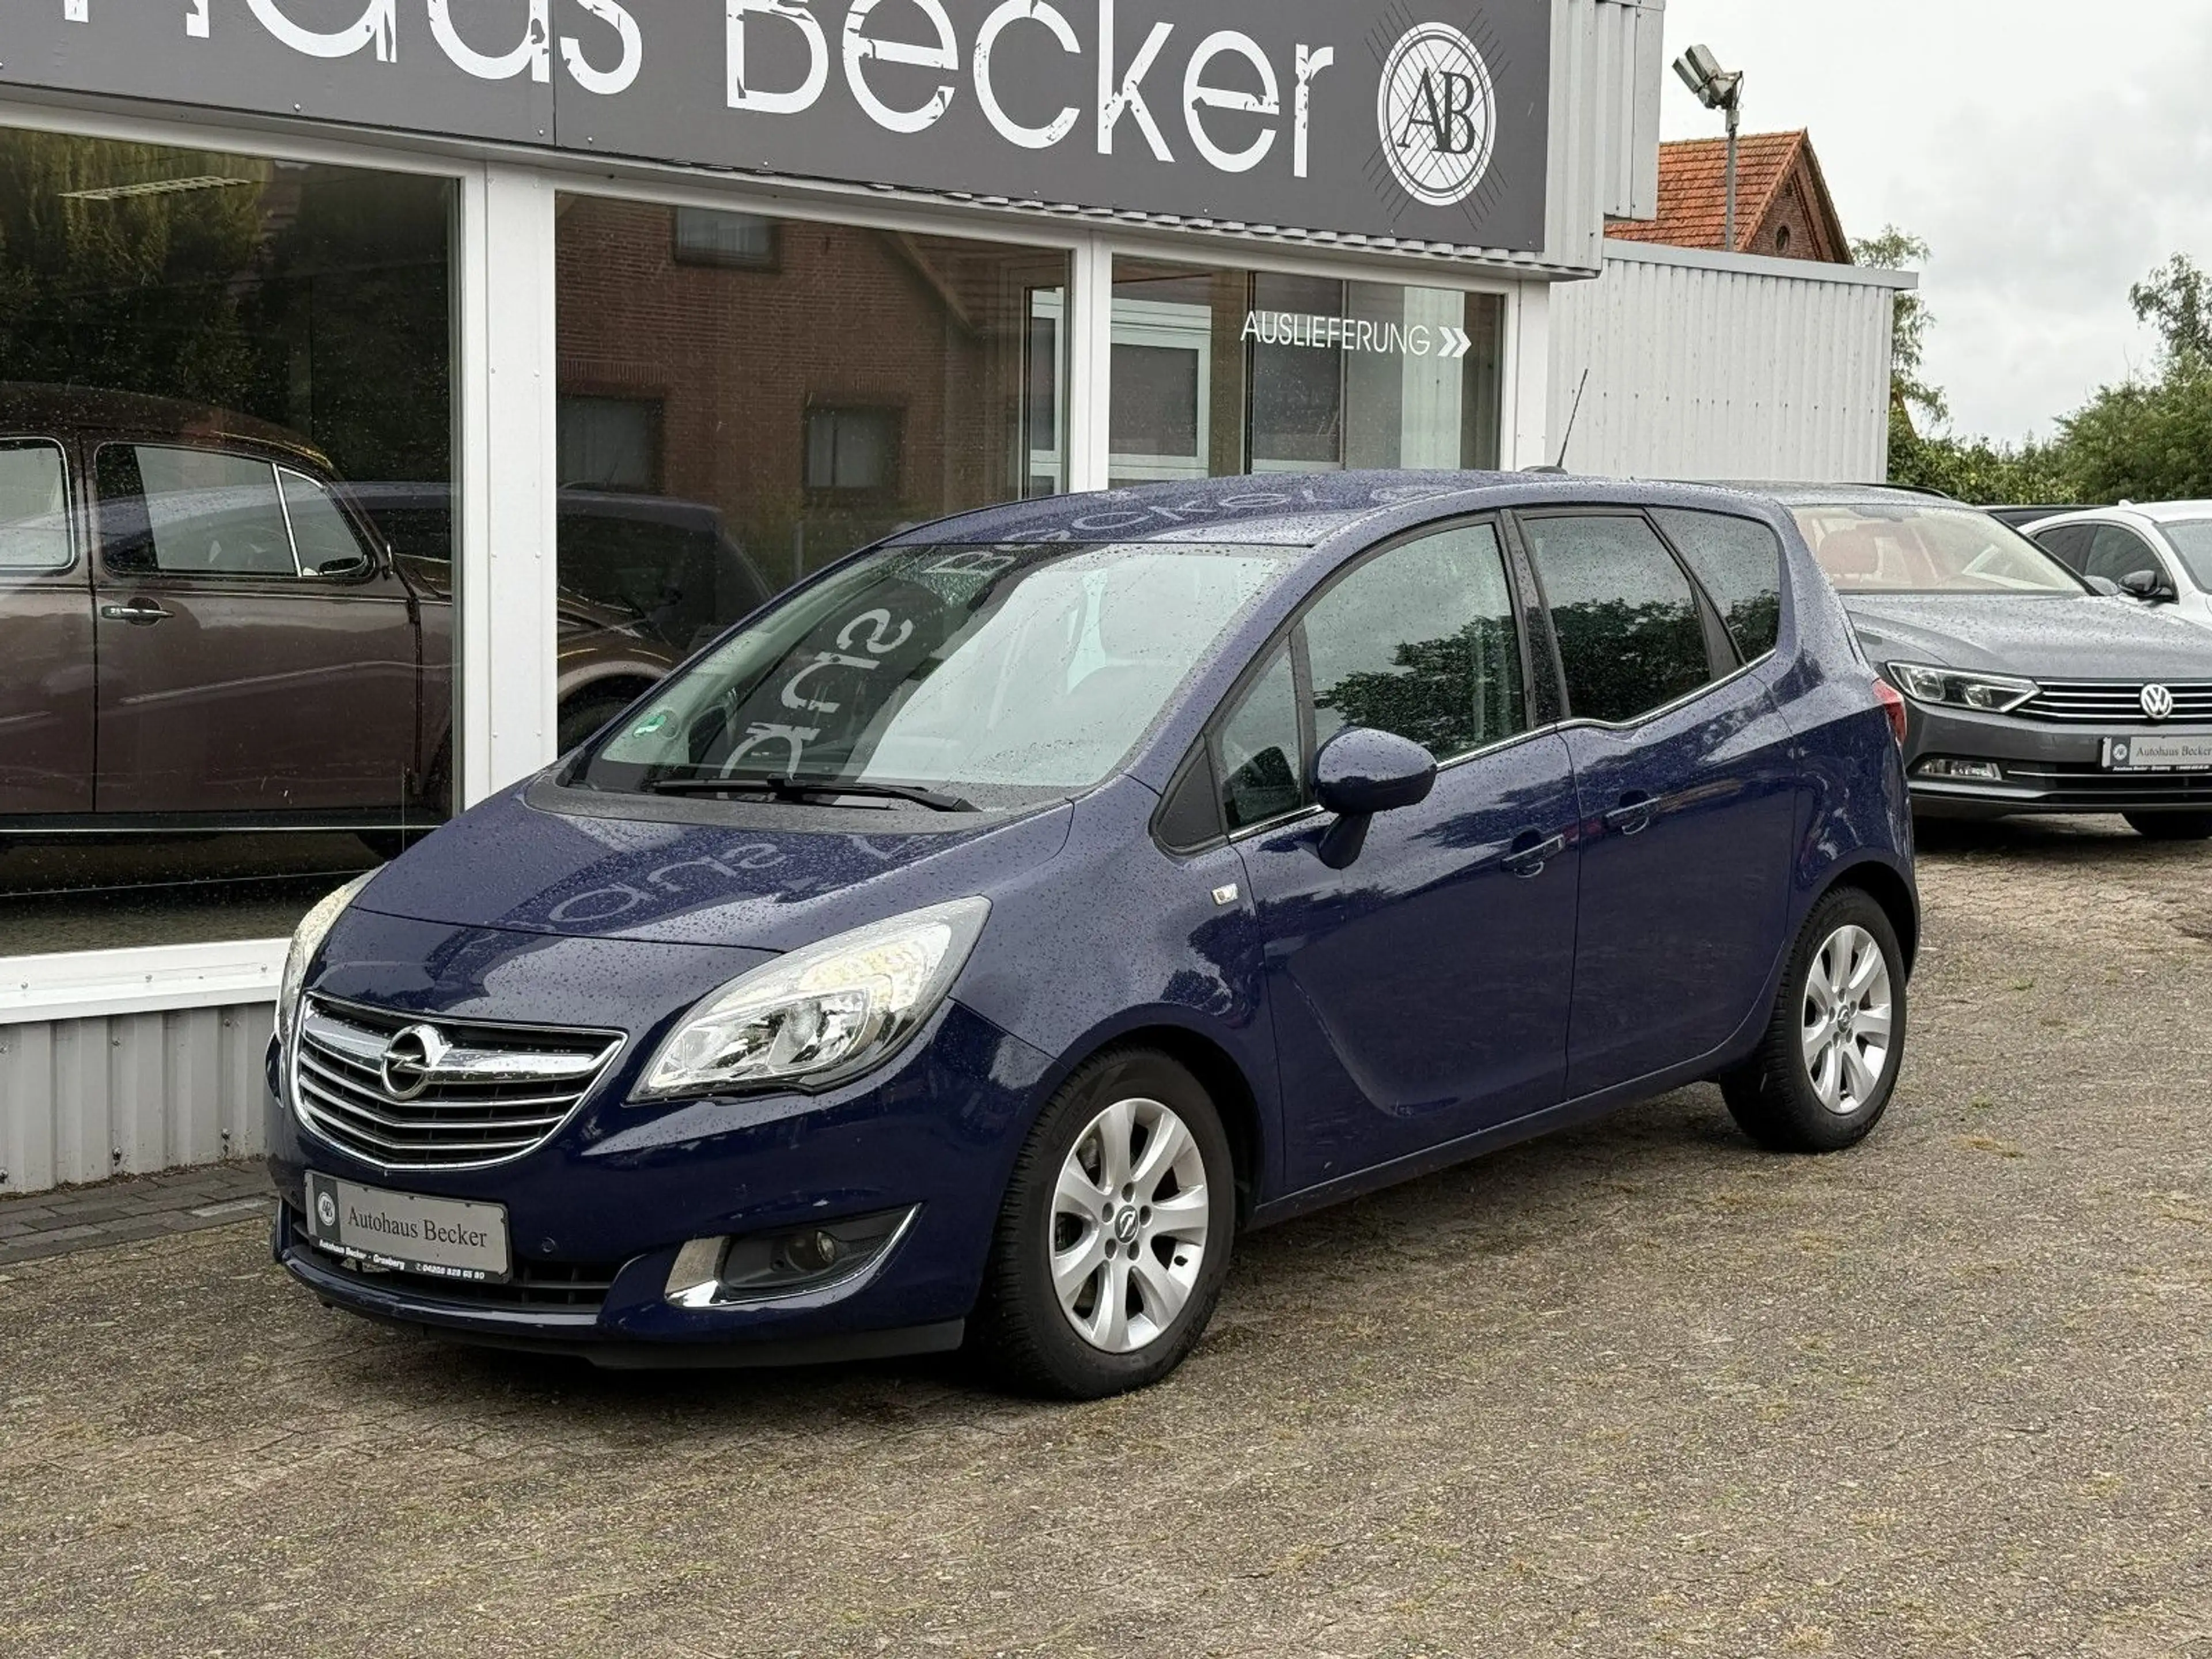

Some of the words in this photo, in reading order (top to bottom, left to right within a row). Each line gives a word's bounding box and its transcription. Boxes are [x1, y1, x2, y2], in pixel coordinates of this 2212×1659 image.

[1396, 67, 1475, 154] AB
[1240, 310, 1430, 356] AUSLIEFERUNG
[2135, 747, 2179, 756] Autohaus
[348, 1206, 419, 1238] Autohaus
[423, 1219, 487, 1248] Becker
